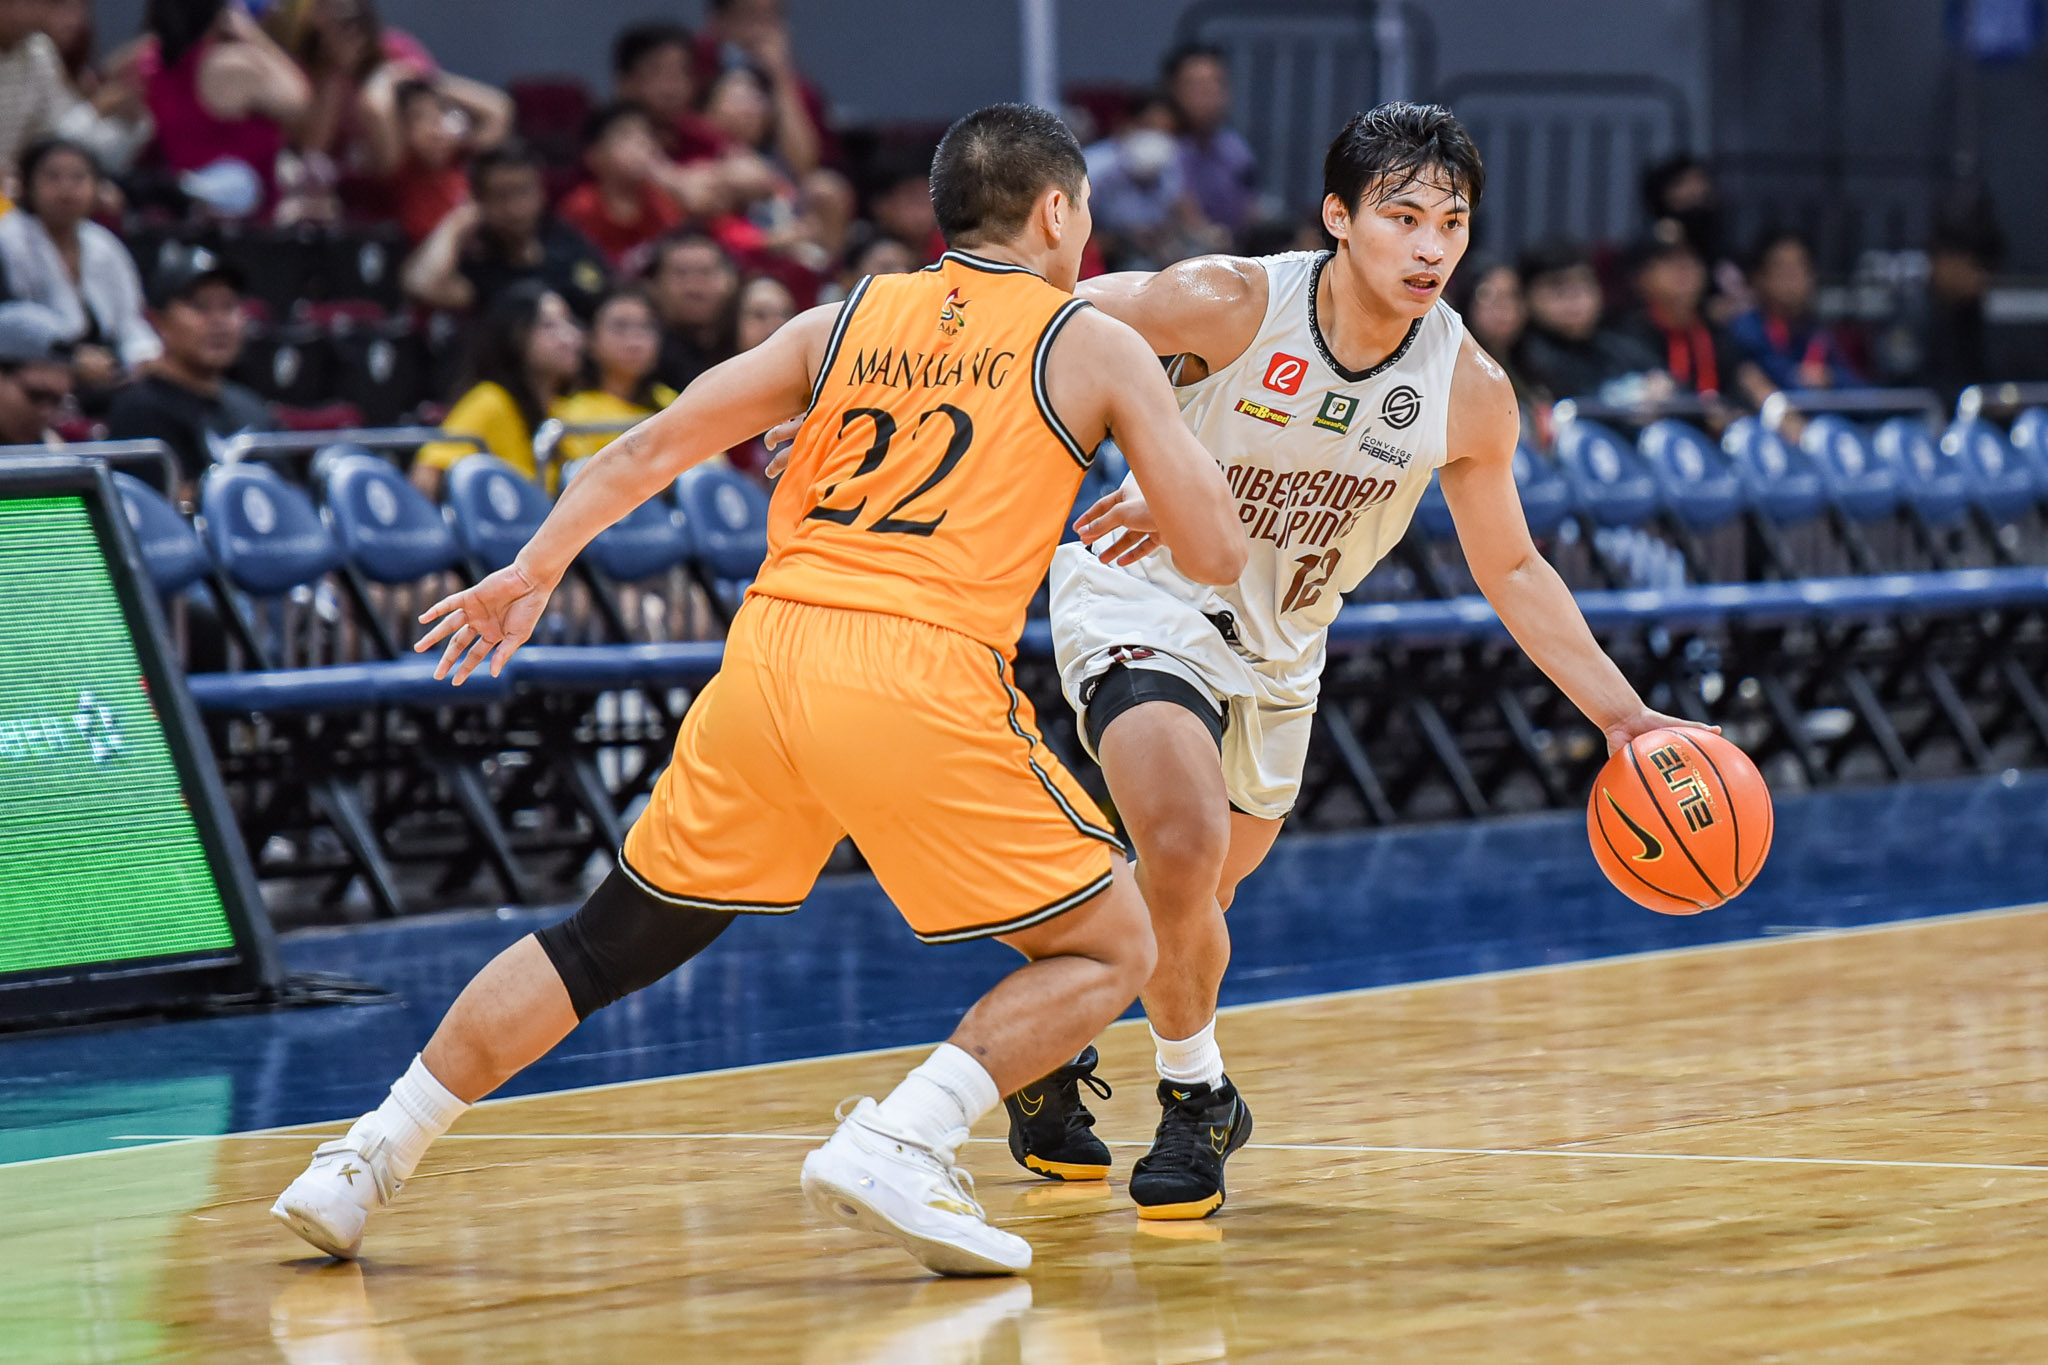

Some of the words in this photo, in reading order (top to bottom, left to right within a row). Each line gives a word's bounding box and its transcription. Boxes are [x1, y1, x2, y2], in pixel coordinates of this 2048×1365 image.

[1240, 399, 1290, 424] TopBreed
[1315, 416, 1348, 432] PalawanPay
[802, 403, 974, 537] 22
[1215, 459, 1397, 511] NIBERSIDAD
[1280, 547, 1342, 615] 12
[1648, 745, 1714, 834] ELITE
